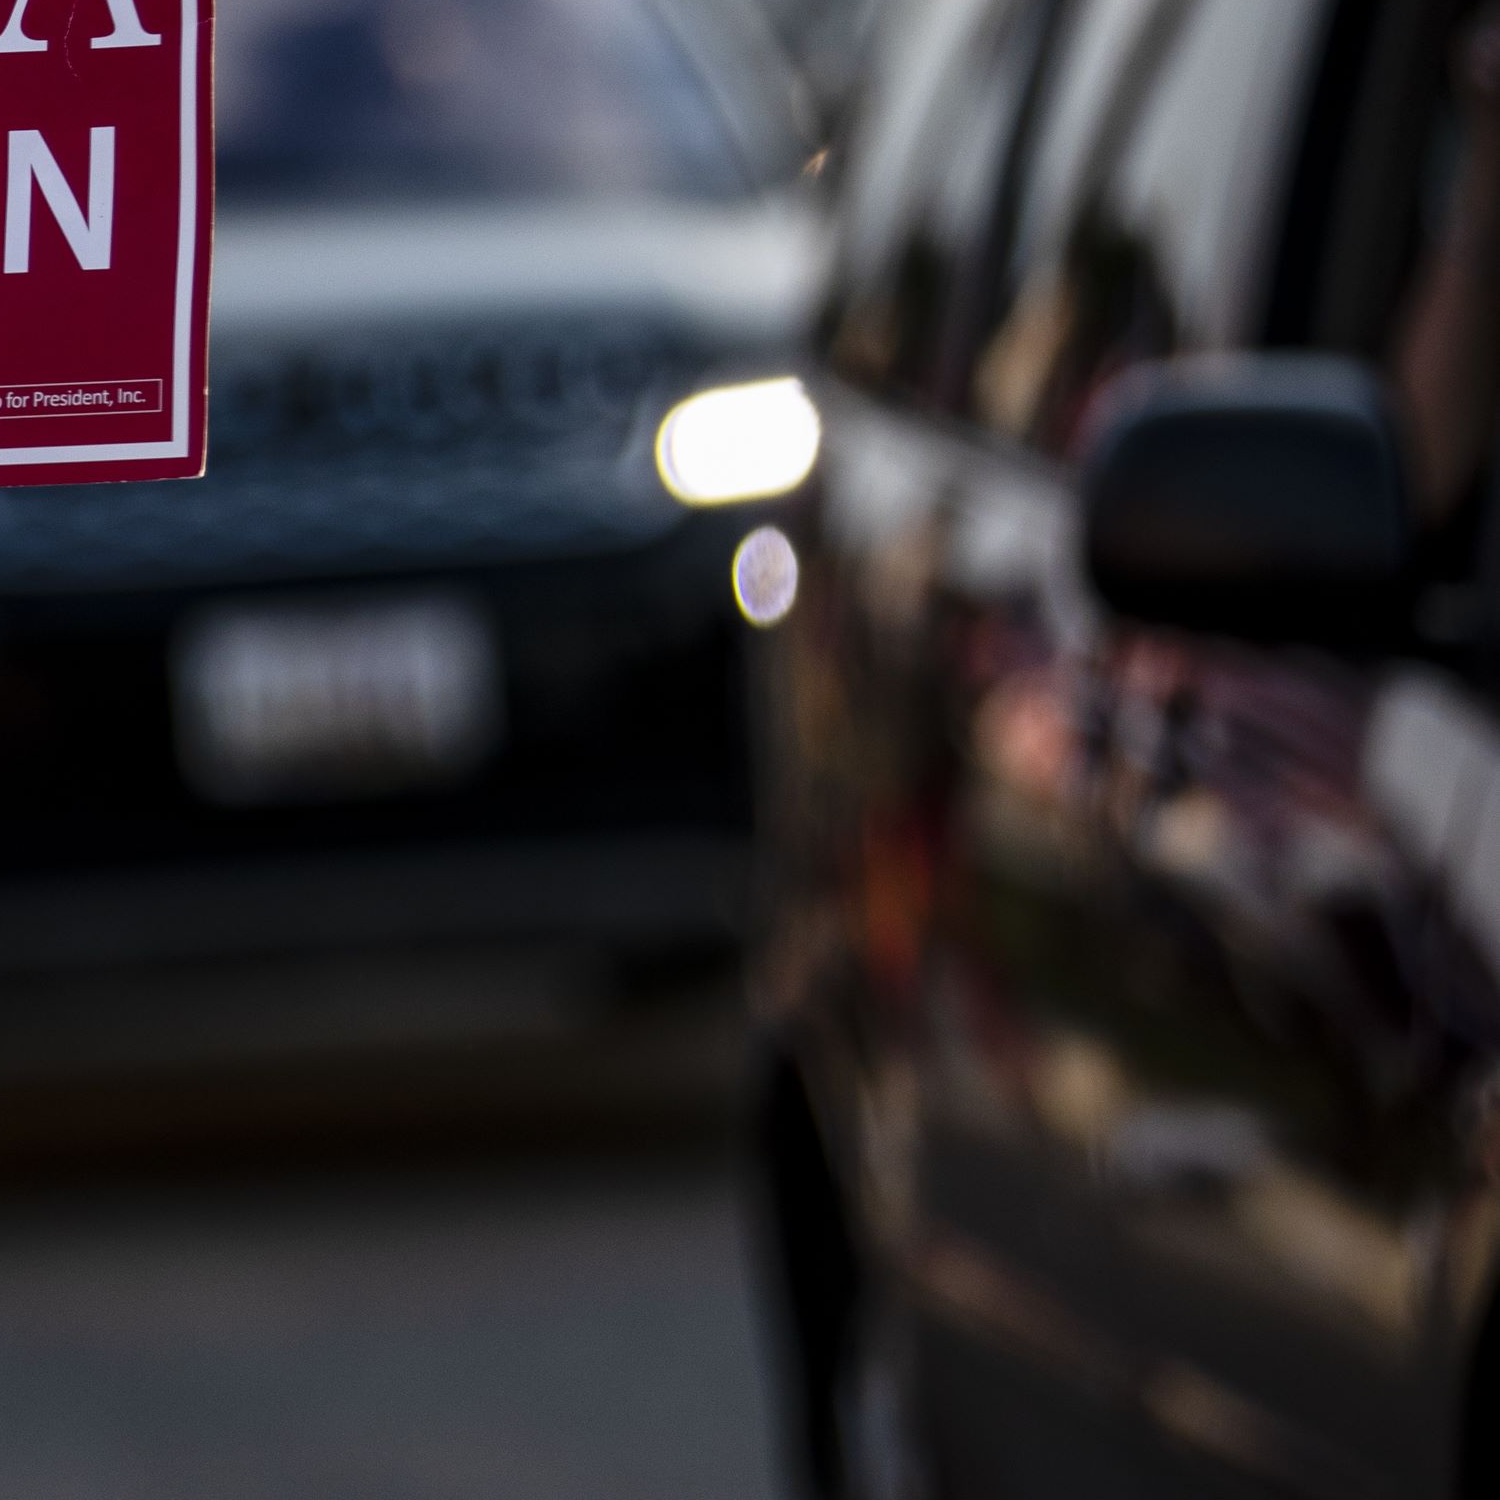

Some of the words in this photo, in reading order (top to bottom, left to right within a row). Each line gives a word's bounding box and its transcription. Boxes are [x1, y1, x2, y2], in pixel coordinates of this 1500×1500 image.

[6, 391, 30, 409] for
[33, 389, 114, 407] President,
[117, 388, 146, 404] Inc.
